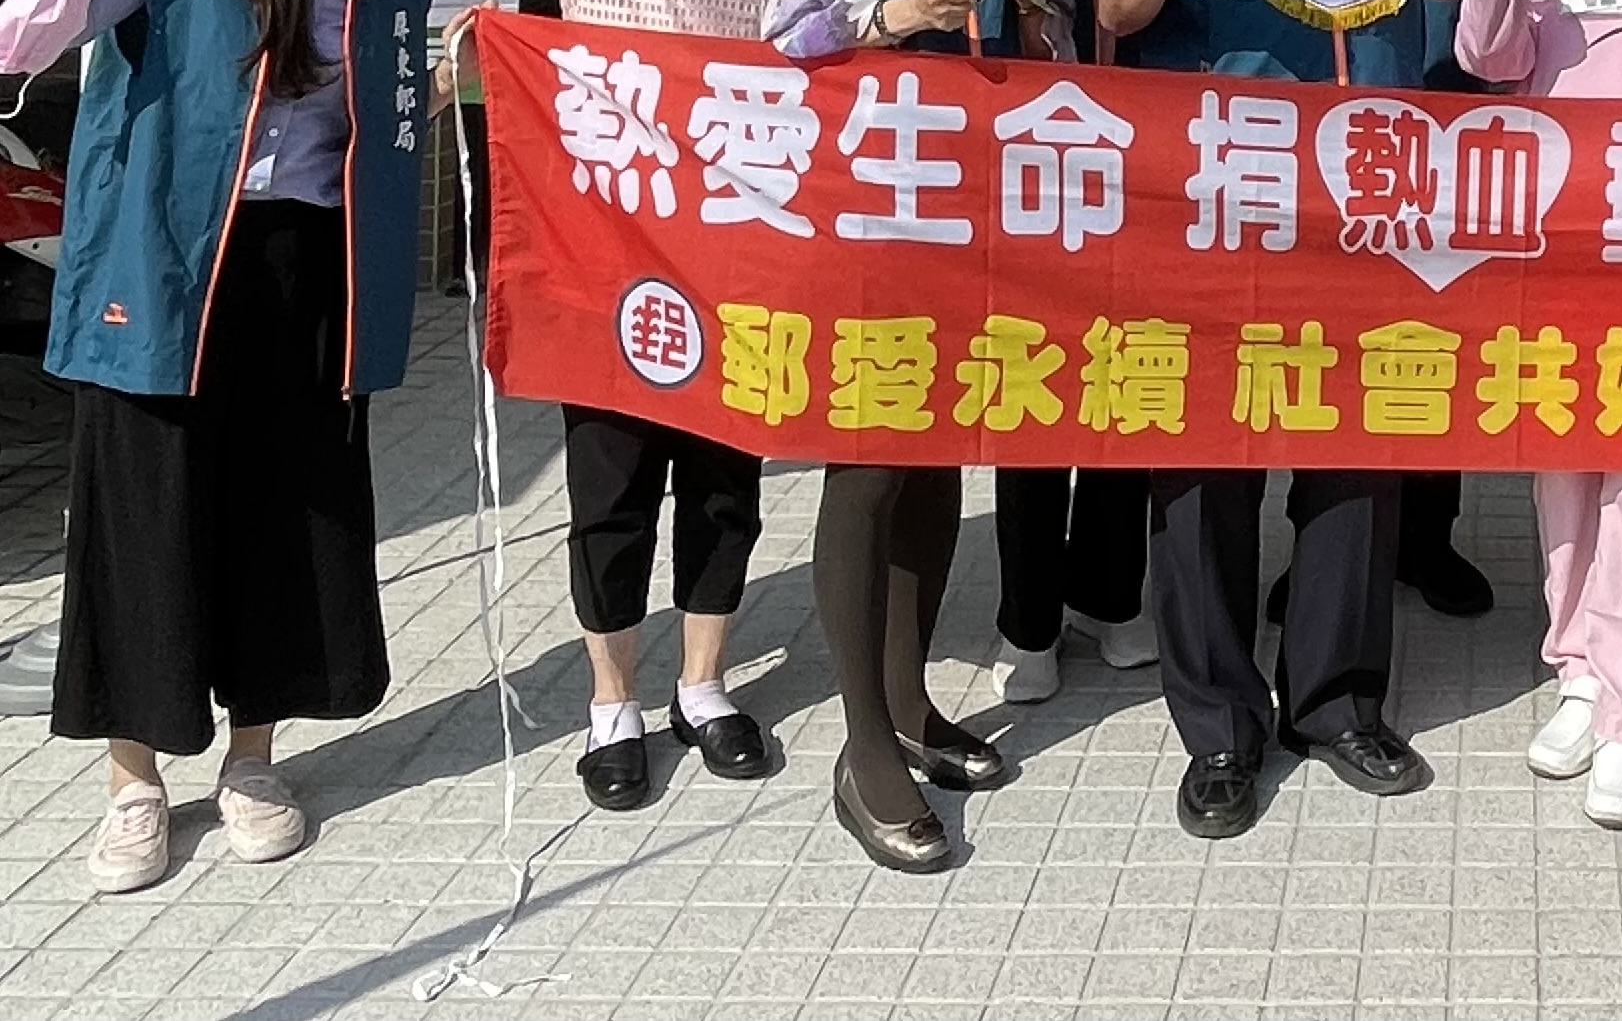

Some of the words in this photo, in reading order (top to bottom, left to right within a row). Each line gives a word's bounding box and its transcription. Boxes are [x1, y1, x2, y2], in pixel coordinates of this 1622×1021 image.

[393, 10, 417, 153] 屏東郵局
[547, 44, 1135, 252] 熱愛生命
[1184, 89, 1300, 252] 捐
[1340, 108, 1546, 253] 熱血
[716, 302, 1191, 435] 郵愛永續
